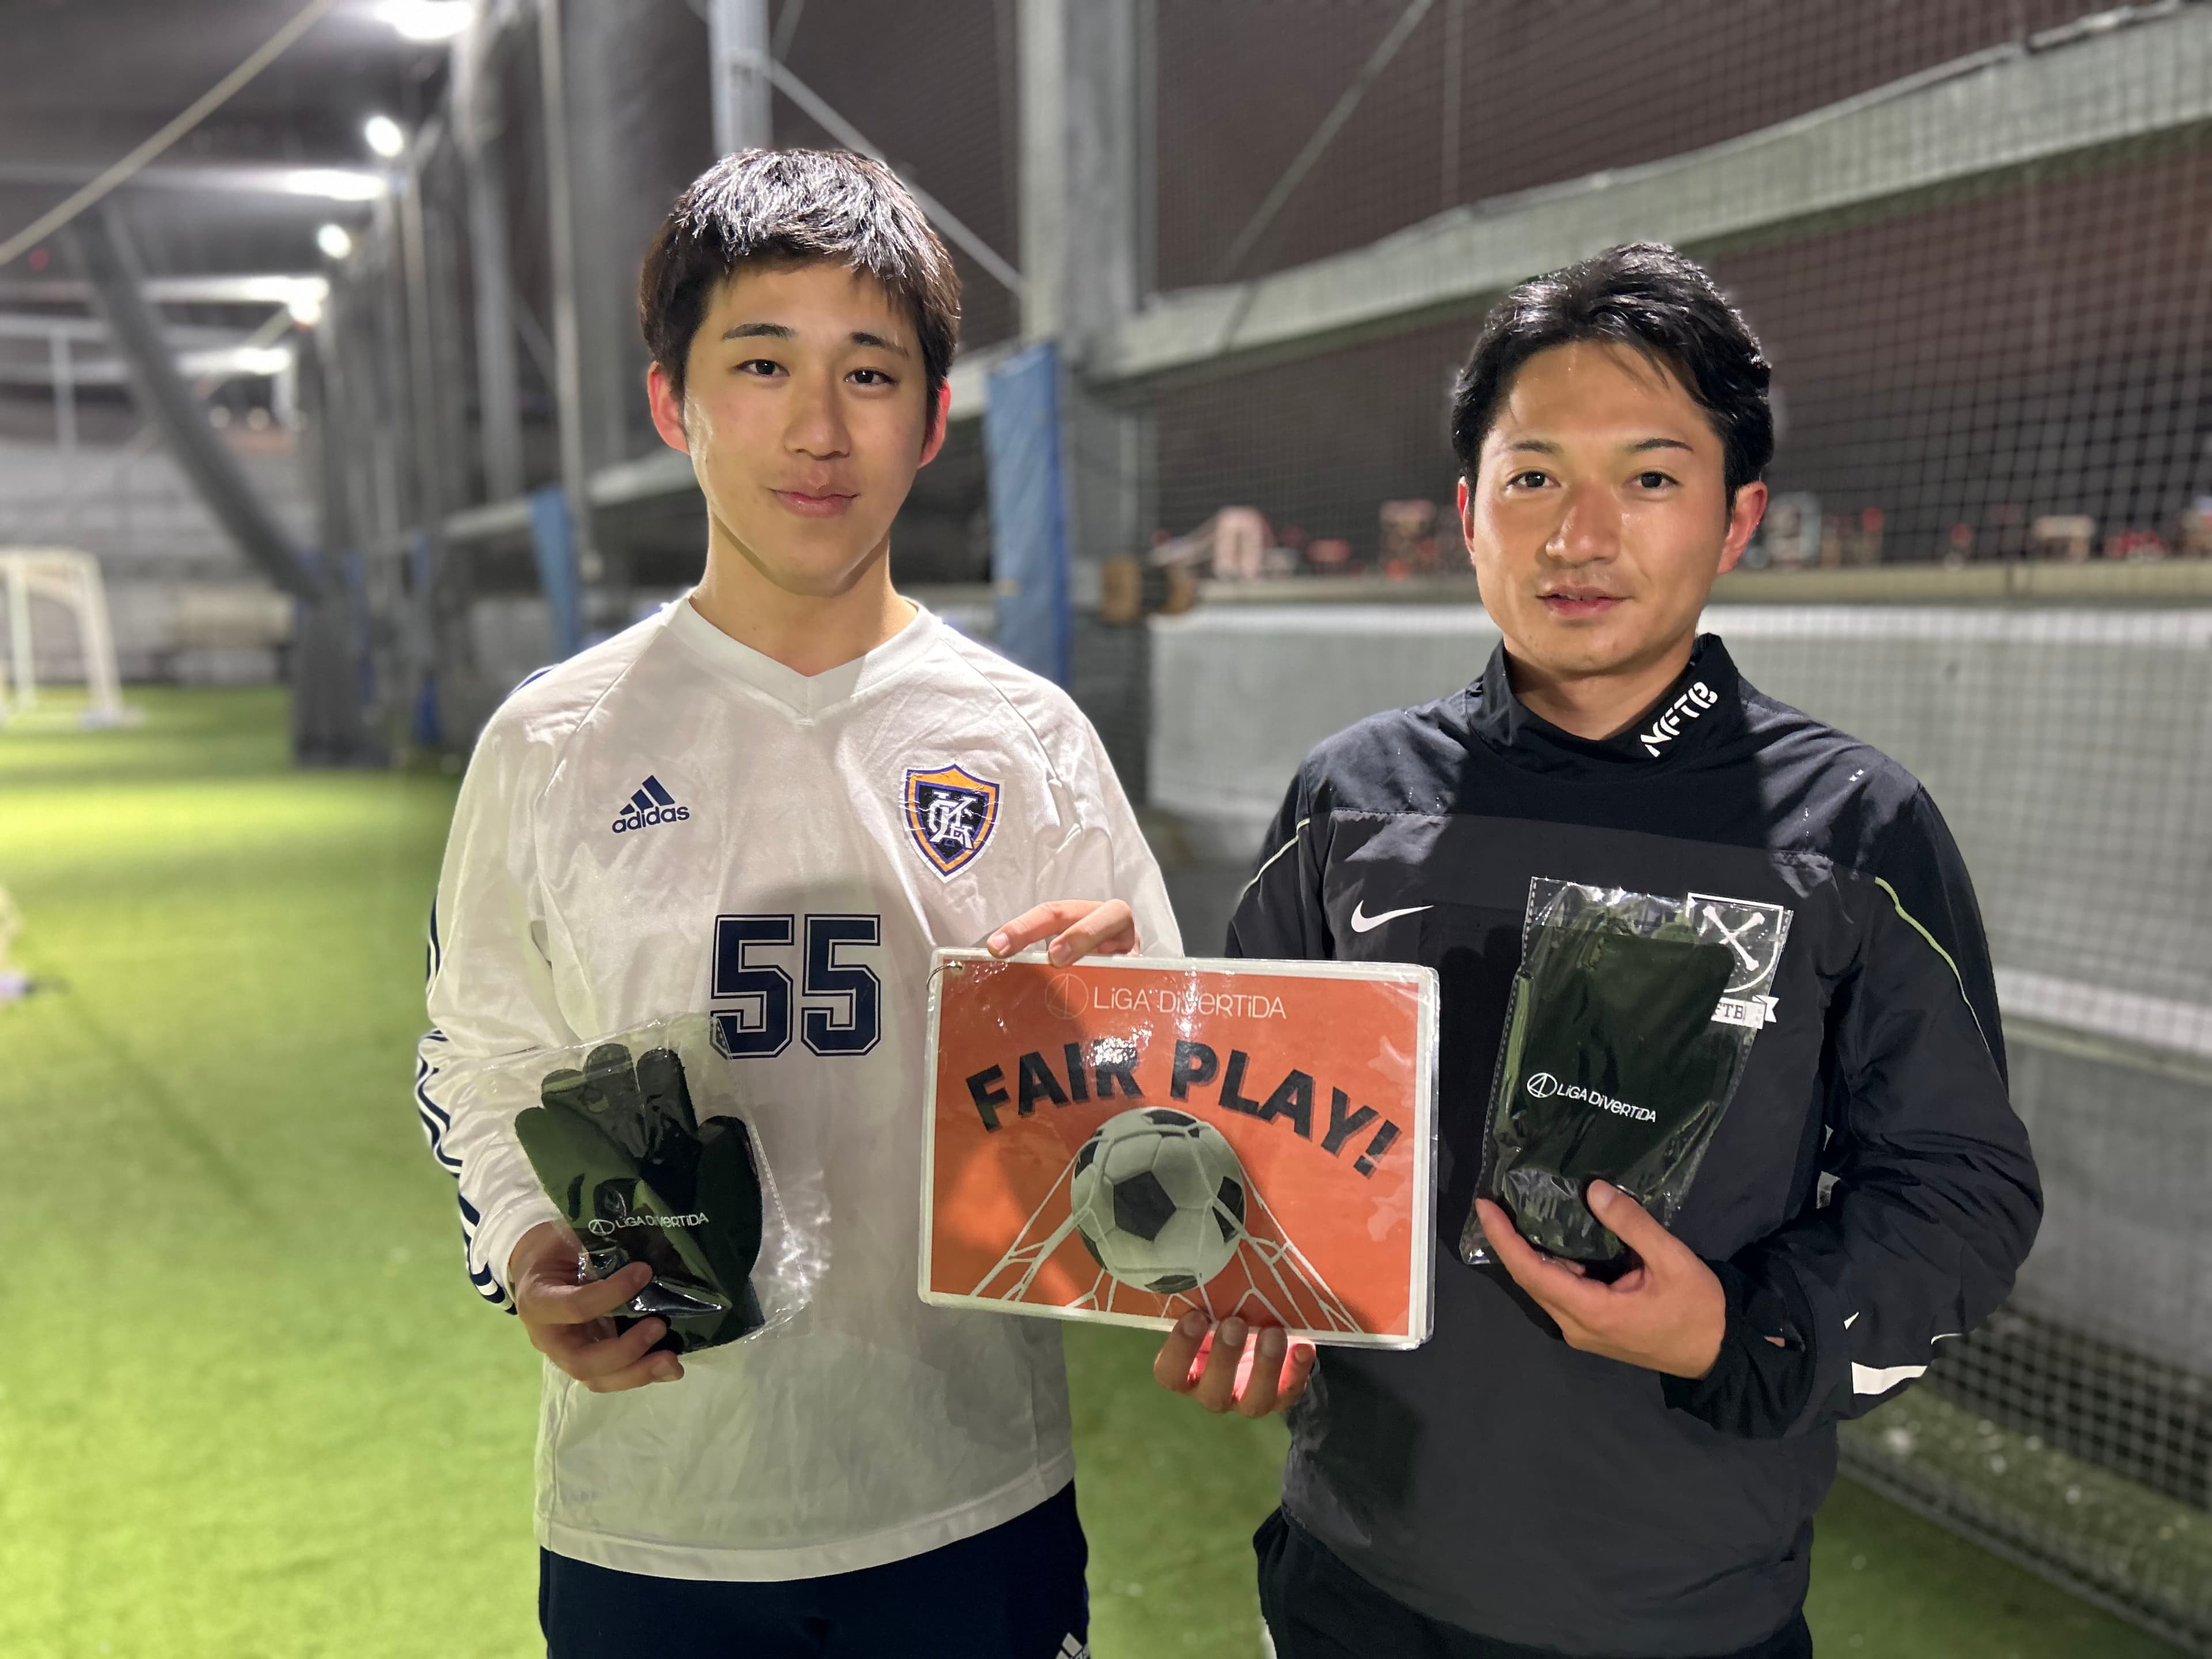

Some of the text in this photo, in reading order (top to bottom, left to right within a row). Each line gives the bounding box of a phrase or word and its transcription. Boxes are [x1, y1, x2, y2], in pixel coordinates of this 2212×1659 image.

[612, 805, 690, 834] adidas
[709, 914, 881, 1059] 55
[965, 1037, 1402, 1179] FAIR PLAY!
